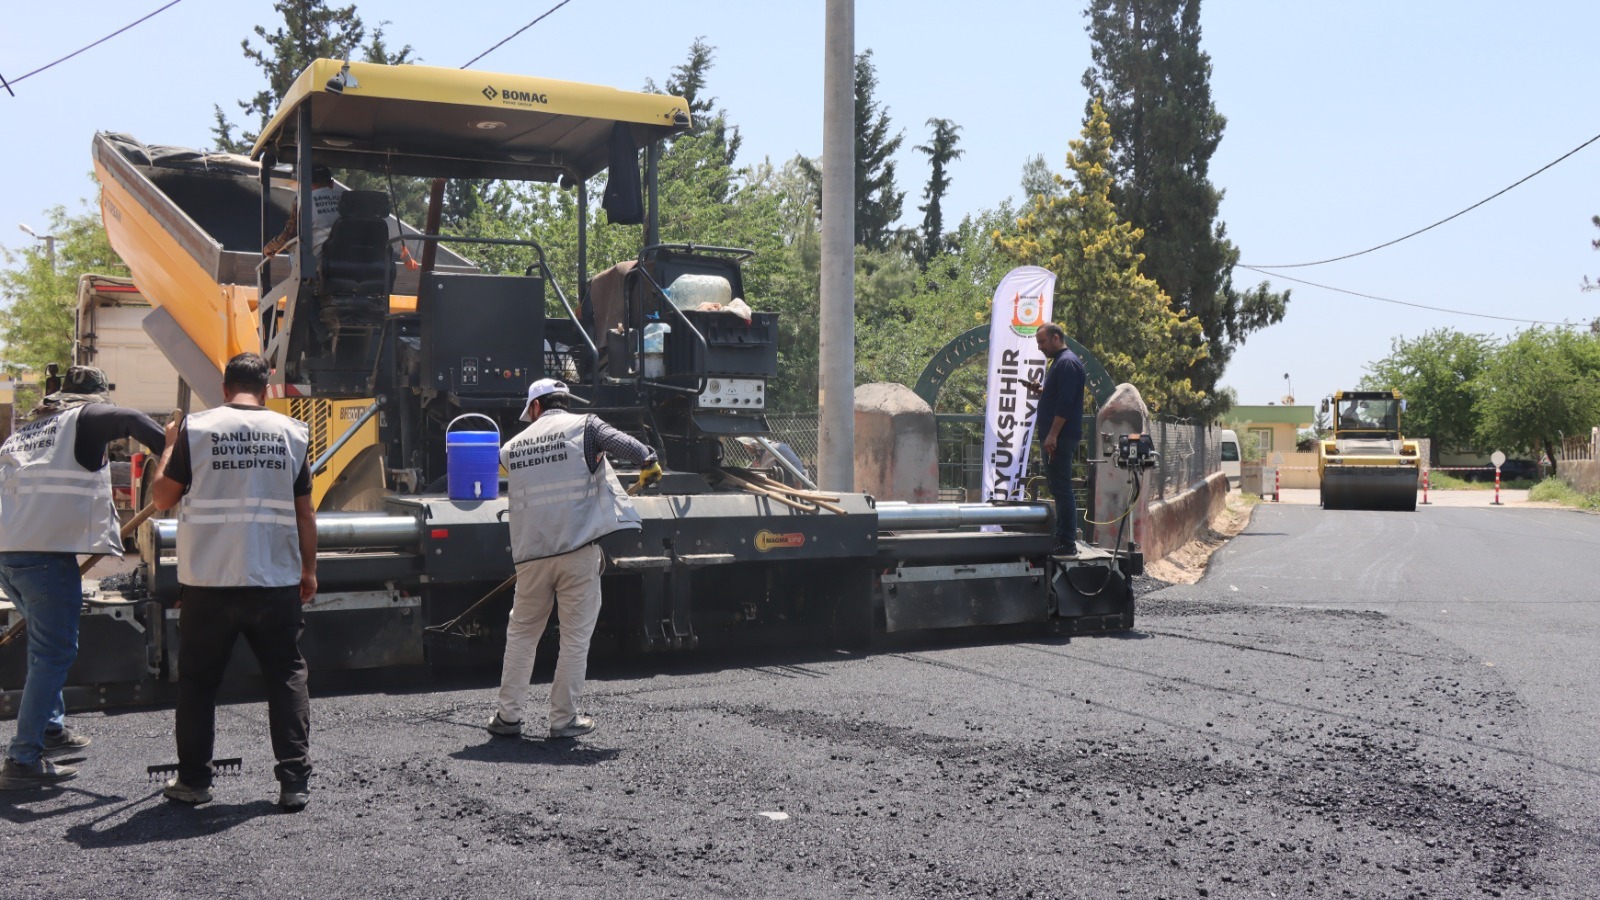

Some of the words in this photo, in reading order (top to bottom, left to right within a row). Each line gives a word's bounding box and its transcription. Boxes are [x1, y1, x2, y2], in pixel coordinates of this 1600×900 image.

[502, 89, 548, 104] BOMAG
[988, 349, 1020, 501] ÜYÜKŞEHİR
[211, 431, 286, 445] ŞANLIURFA
[510, 431, 566, 450] ŞANLIURFA
[212, 443, 287, 456] BÜYÜKŞEHİR
[212, 457, 286, 470] BELEDİYESİ
[510, 451, 568, 471] BELEDİYESİ
